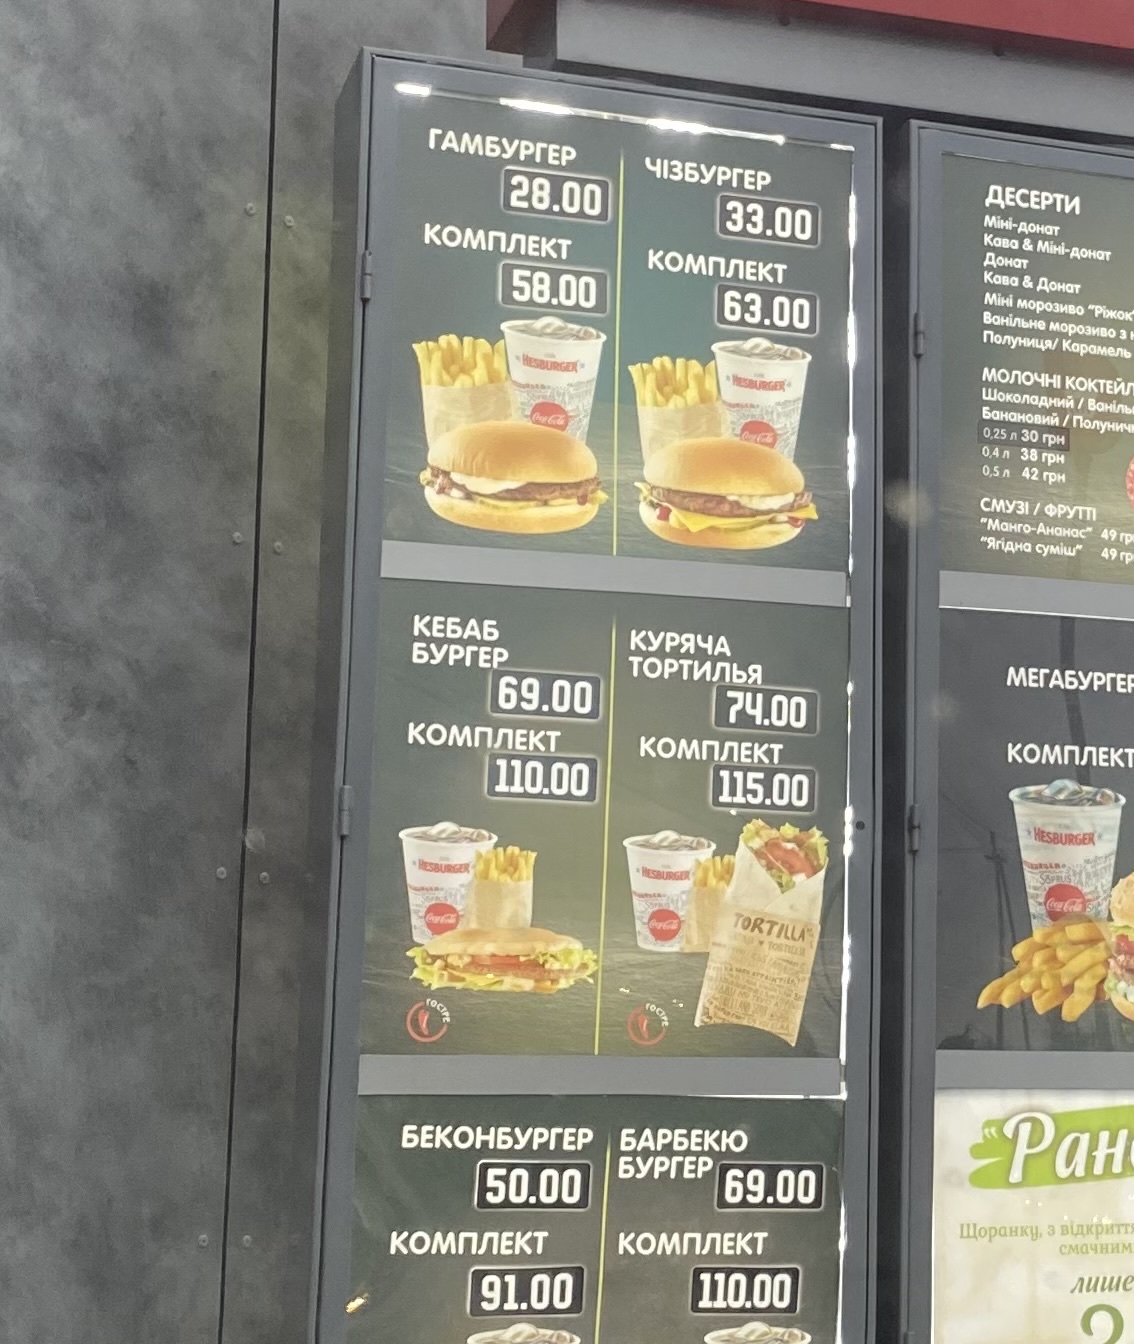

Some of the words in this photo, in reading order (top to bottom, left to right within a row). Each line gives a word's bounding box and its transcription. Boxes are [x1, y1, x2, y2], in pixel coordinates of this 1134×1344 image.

[428, 127, 577, 167] ГАМБУРГЕР
[645, 156, 772, 192] ЧІЗБУРГЕР
[508, 174, 603, 217] 28.00
[985, 185, 1080, 215] ДЕСЕРТИ
[724, 200, 813, 242] 33.00
[984, 214, 1060, 236] Міні-донат
[424, 222, 572, 260] КОМПЛЕКТ
[984, 233, 1019, 249] Кава
[1022, 238, 1033, 251] &
[1037, 240, 1112, 261] Міні-донат
[647, 249, 788, 284] КОМПЛЕКТ
[983, 252, 1029, 269] Донат
[511, 269, 597, 309] 58.00
[984, 271, 1019, 287] Кава
[1022, 275, 1033, 288] &
[1037, 277, 1081, 294] Донат
[722, 290, 811, 331] 63.00
[984, 292, 1013, 307] Міні
[1017, 298, 1084, 315] морозиво
[983, 311, 1046, 330] Ванільне
[1049, 321, 1116, 338] морозиво
[1119, 329, 1127, 340] з
[1062, 338, 1132, 358] Карамель
[982, 367, 1061, 388] МОЛОЧНІ
[982, 388, 1074, 408] Шоколадний
[982, 406, 1059, 426] Банановий
[983, 427, 1007, 440] 0,25
[1010, 432, 1017, 441] л
[1021, 429, 1038, 442] 30
[1042, 434, 1065, 446] грн
[982, 446, 999, 459] 0,4
[1002, 450, 1010, 459] л
[1020, 448, 1038, 461] 38
[1041, 453, 1065, 466] грн
[982, 465, 999, 478] 0,5
[1002, 468, 1010, 478] л
[1021, 467, 1039, 481] 42
[1043, 471, 1065, 485] грн
[980, 498, 1029, 515] СМУЗІ
[1044, 503, 1097, 521] ФРУТТІ
[1101, 528, 1117, 541] 49
[1101, 548, 1117, 560] 49
[413, 614, 499, 642] КЕБАБ
[411, 642, 509, 668] БУРГЕР
[629, 629, 731, 657] КУРЯЧА
[629, 657, 763, 685] ТОРТИЛЬЯ
[498, 677, 593, 715] 69.00
[726, 690, 808, 728] 74.00
[407, 722, 562, 752] КОМПЛЕКТ
[640, 736, 783, 764] КОМПЛЕКТ
[494, 759, 589, 796] 110.00
[718, 770, 809, 807] 115.00
[1034, 827, 1095, 846] HESBURGER
[418, 859, 470, 873] HESBURGER
[641, 866, 690, 881] HESBURGER
[734, 912, 805, 942] TORTILLA
[400, 1124, 594, 1151] БЕКОНБУРГЕР
[619, 1128, 749, 1153] БАРБЕКЮ
[617, 1156, 714, 1179] БУРГЕР
[485, 1168, 582, 1204] 50.00
[723, 1168, 816, 1204] 69.00
[389, 1231, 549, 1256] КОМПЛЕКТ
[618, 1231, 768, 1256] КОМПЛЕКТ
[959, 1223, 1042, 1242] Щоранку,
[480, 1274, 574, 1310] 91.00
[697, 1273, 792, 1309] 110.00
[1070, 1274, 1134, 1294] лише
